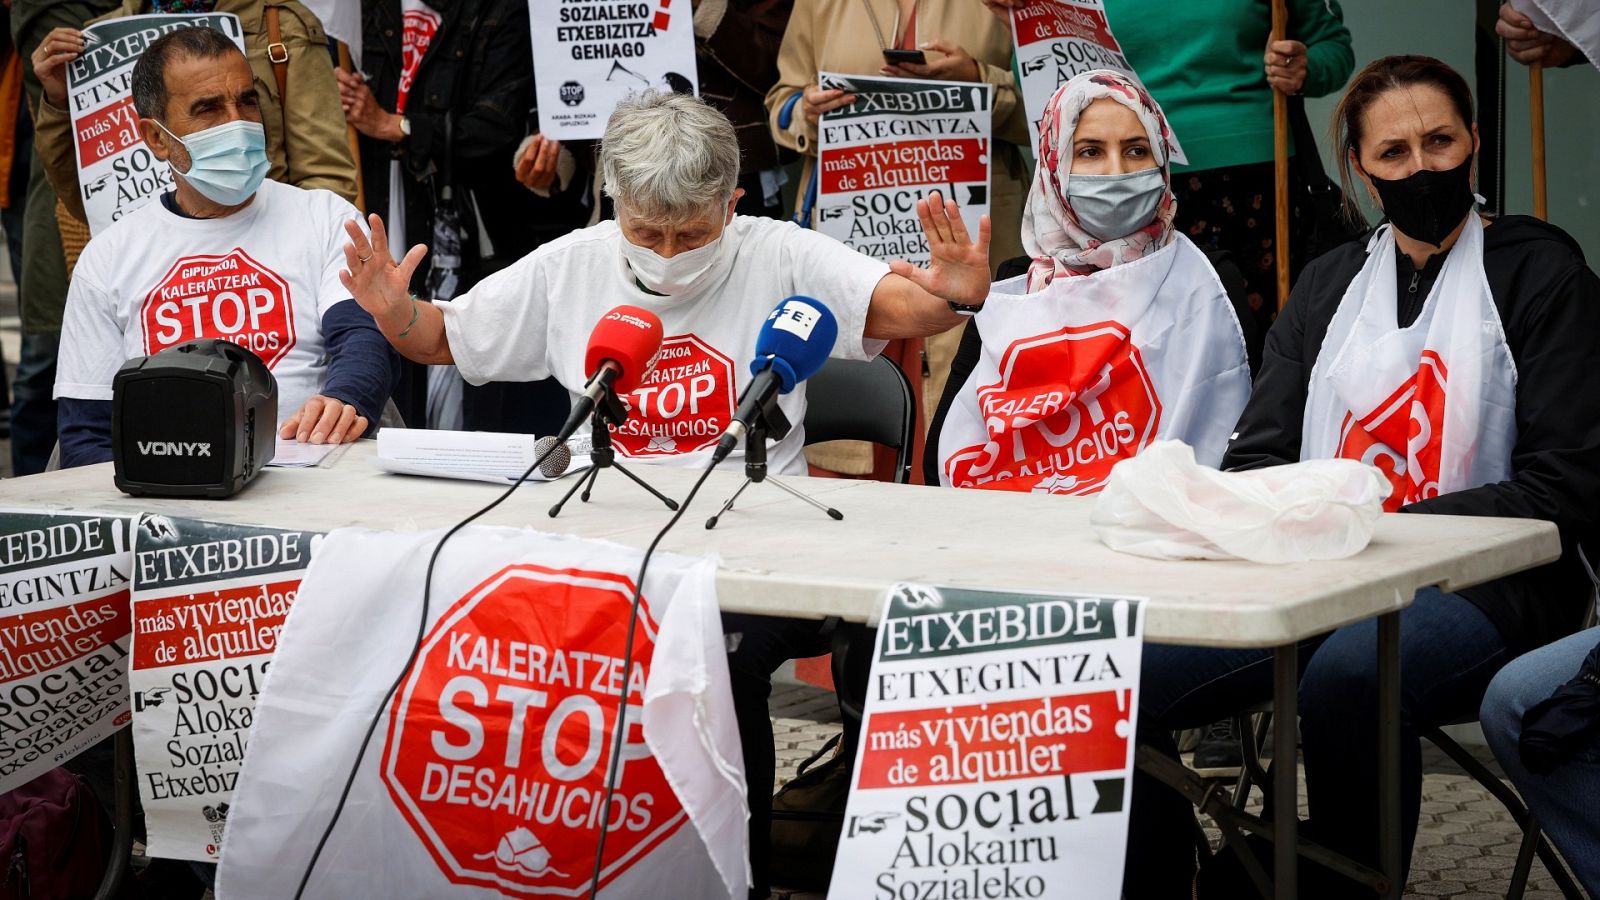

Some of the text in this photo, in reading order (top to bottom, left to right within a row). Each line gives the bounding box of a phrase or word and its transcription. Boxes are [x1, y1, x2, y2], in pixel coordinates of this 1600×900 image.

[560, 4, 649, 23] SOZIALEKO
[557, 22, 657, 42] ETXEBIZITZA
[1035, 21, 1052, 38] de
[571, 42, 645, 60] GEHIAGO
[561, 86, 583, 96] STOP
[79, 118, 111, 142] más
[823, 118, 980, 144] ETXEGINTZA
[96, 139, 115, 158] de
[824, 140, 965, 171] más viviendas
[838, 160, 950, 190] de alquiler
[161, 272, 261, 301] KALERATZEAK
[155, 287, 275, 345] STOP
[137, 441, 211, 456] VONYX
[137, 532, 302, 584] ETXEBIDE
[139, 584, 297, 635] más viviendas
[884, 598, 1102, 656] ETXEBIDE
[155, 638, 177, 663] de
[877, 652, 1122, 702] ETXEGINTZA
[870, 697, 1093, 751] más viviendas
[887, 733, 1066, 785] de alquiler
[420, 762, 654, 832] DESAHUCIOS
[905, 774, 1080, 833] social
[889, 826, 1059, 869] Alokairu
[875, 866, 1046, 900] Sozialeko
